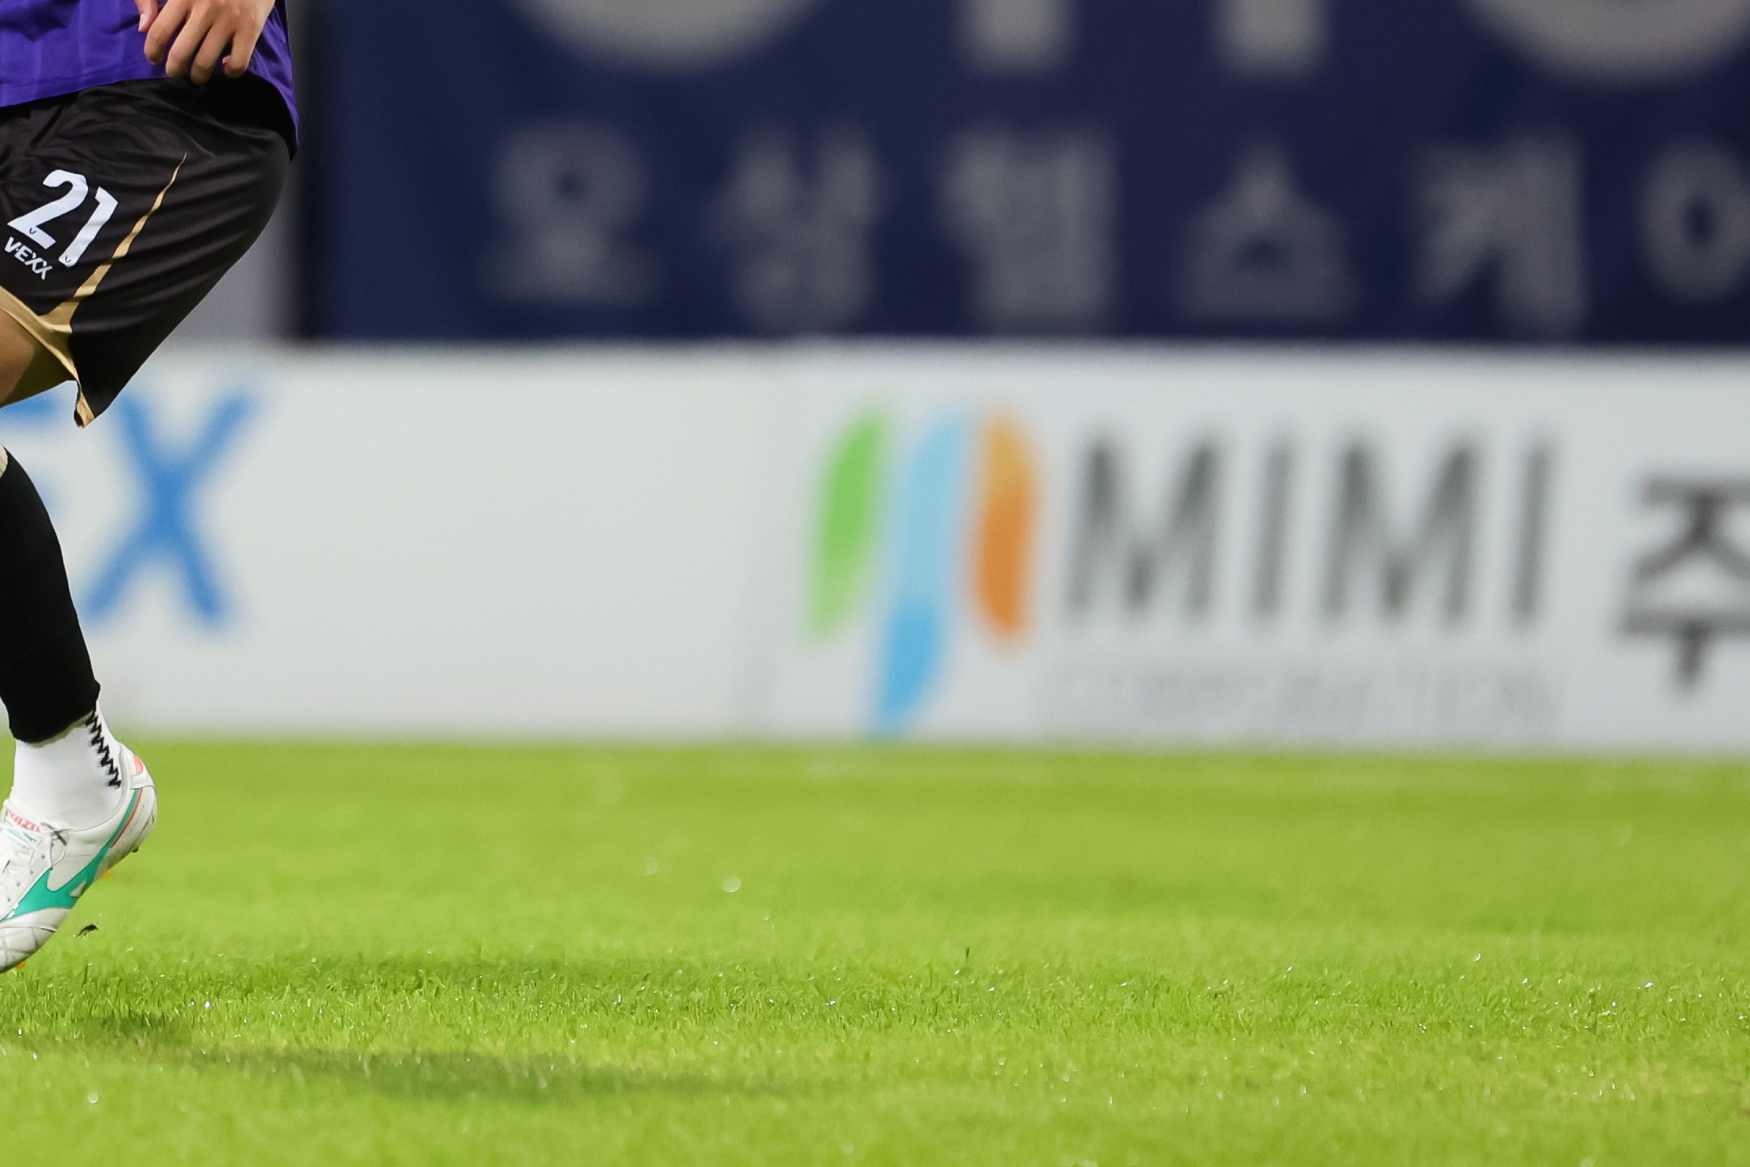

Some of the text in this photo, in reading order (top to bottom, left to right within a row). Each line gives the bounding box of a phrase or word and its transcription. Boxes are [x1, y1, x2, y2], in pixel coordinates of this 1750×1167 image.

[4, 236, 52, 281] VEXX
[7, 169, 119, 268] 21
[1060, 423, 1562, 630] MIMI
